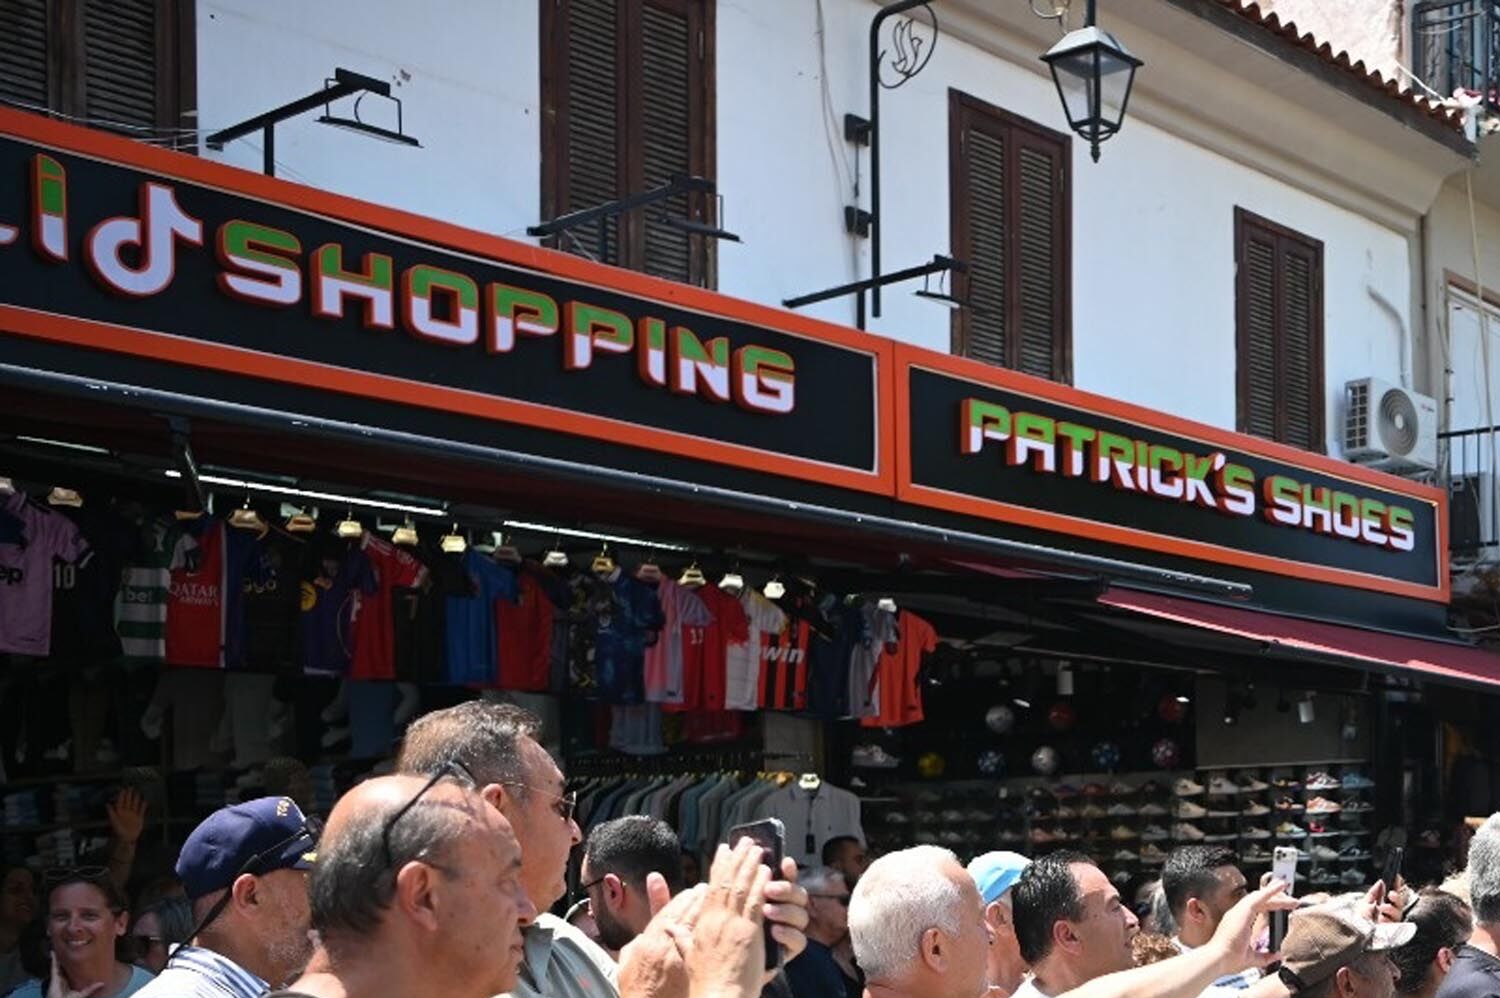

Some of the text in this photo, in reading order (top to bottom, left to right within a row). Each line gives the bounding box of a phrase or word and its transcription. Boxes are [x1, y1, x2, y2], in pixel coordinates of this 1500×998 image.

[216, 218, 796, 415] SHOPPING
[961, 398, 1415, 553] PATRICK'S SHOES
[55, 562, 76, 591] 10
[169, 583, 218, 598] QATAR
